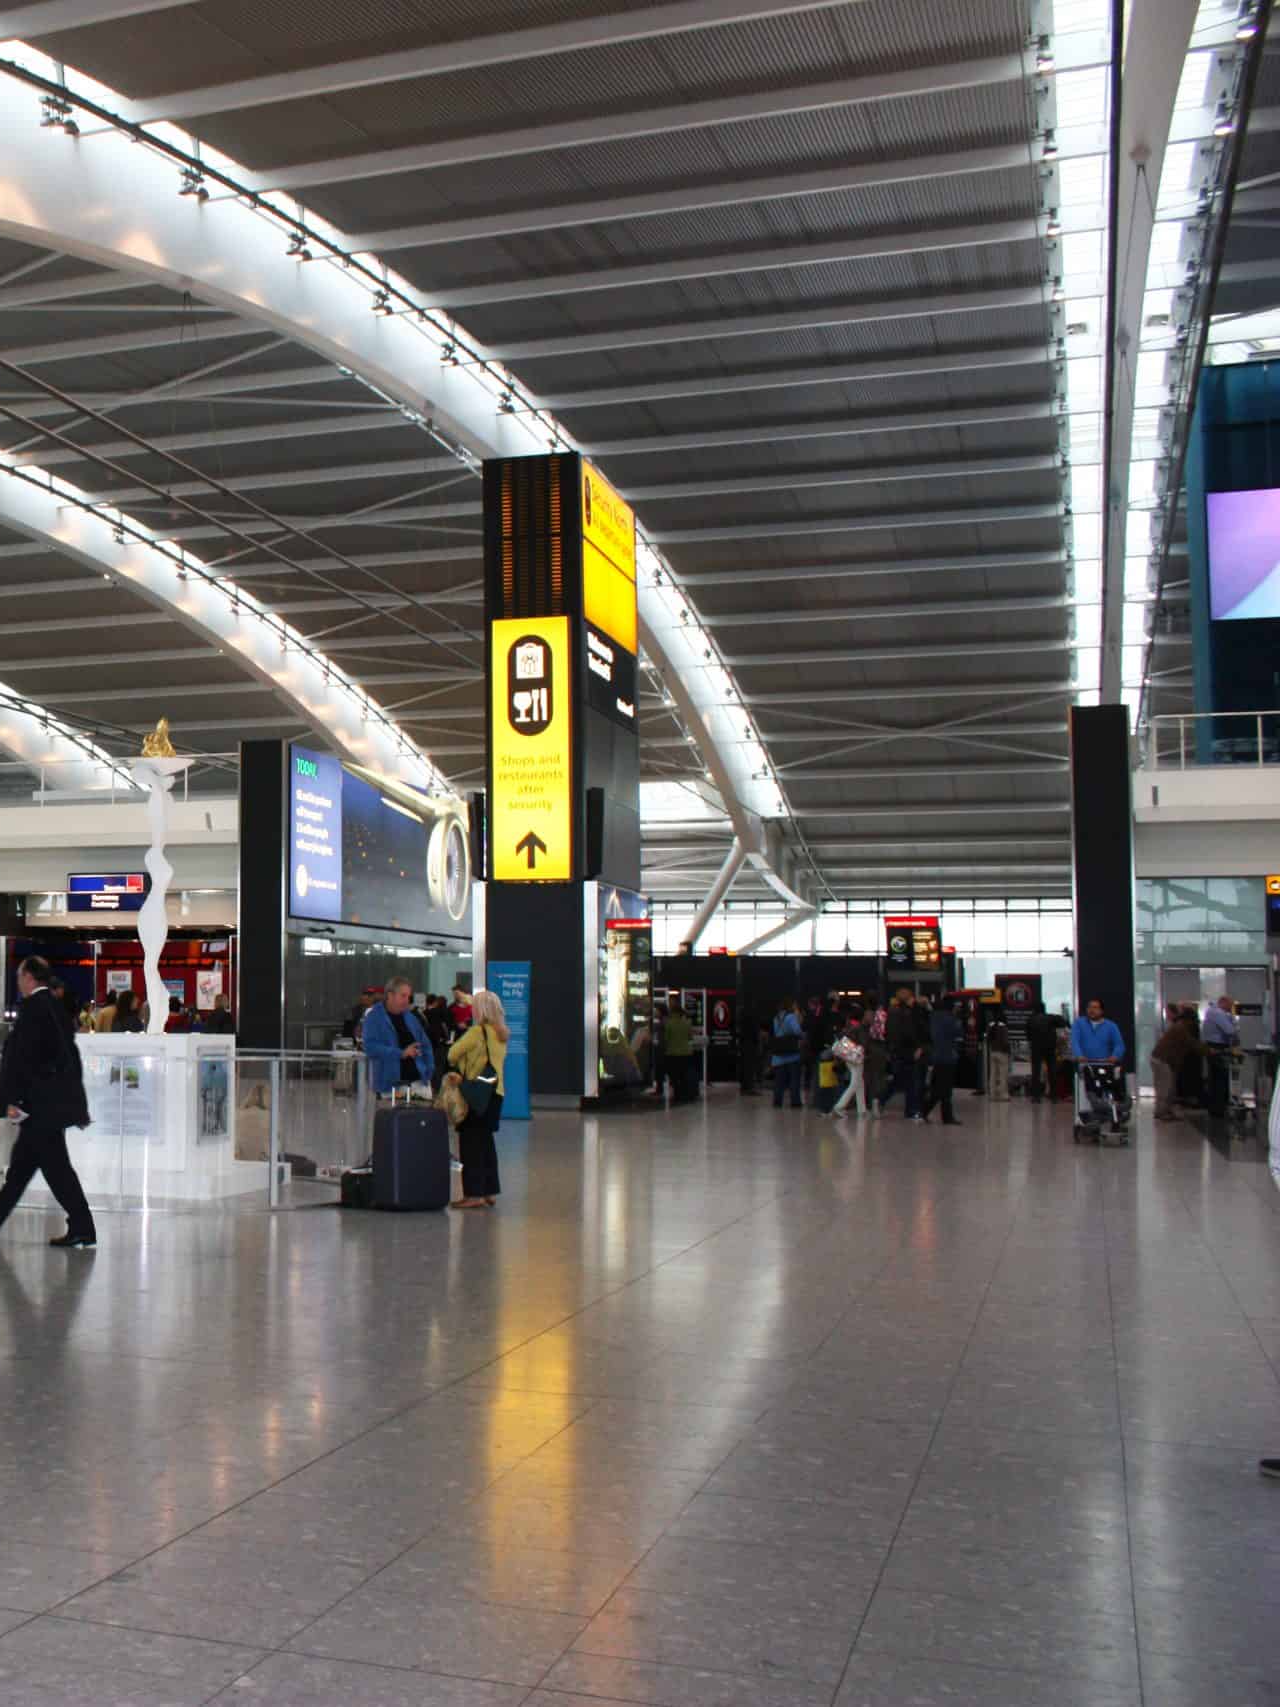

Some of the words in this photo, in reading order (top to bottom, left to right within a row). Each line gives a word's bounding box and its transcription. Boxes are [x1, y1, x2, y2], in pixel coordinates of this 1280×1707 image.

[500, 755, 534, 768] Shops
[539, 753, 561, 765] and
[498, 770, 563, 781] restaurants
[517, 785, 544, 794] after
[507, 800, 552, 812] security
